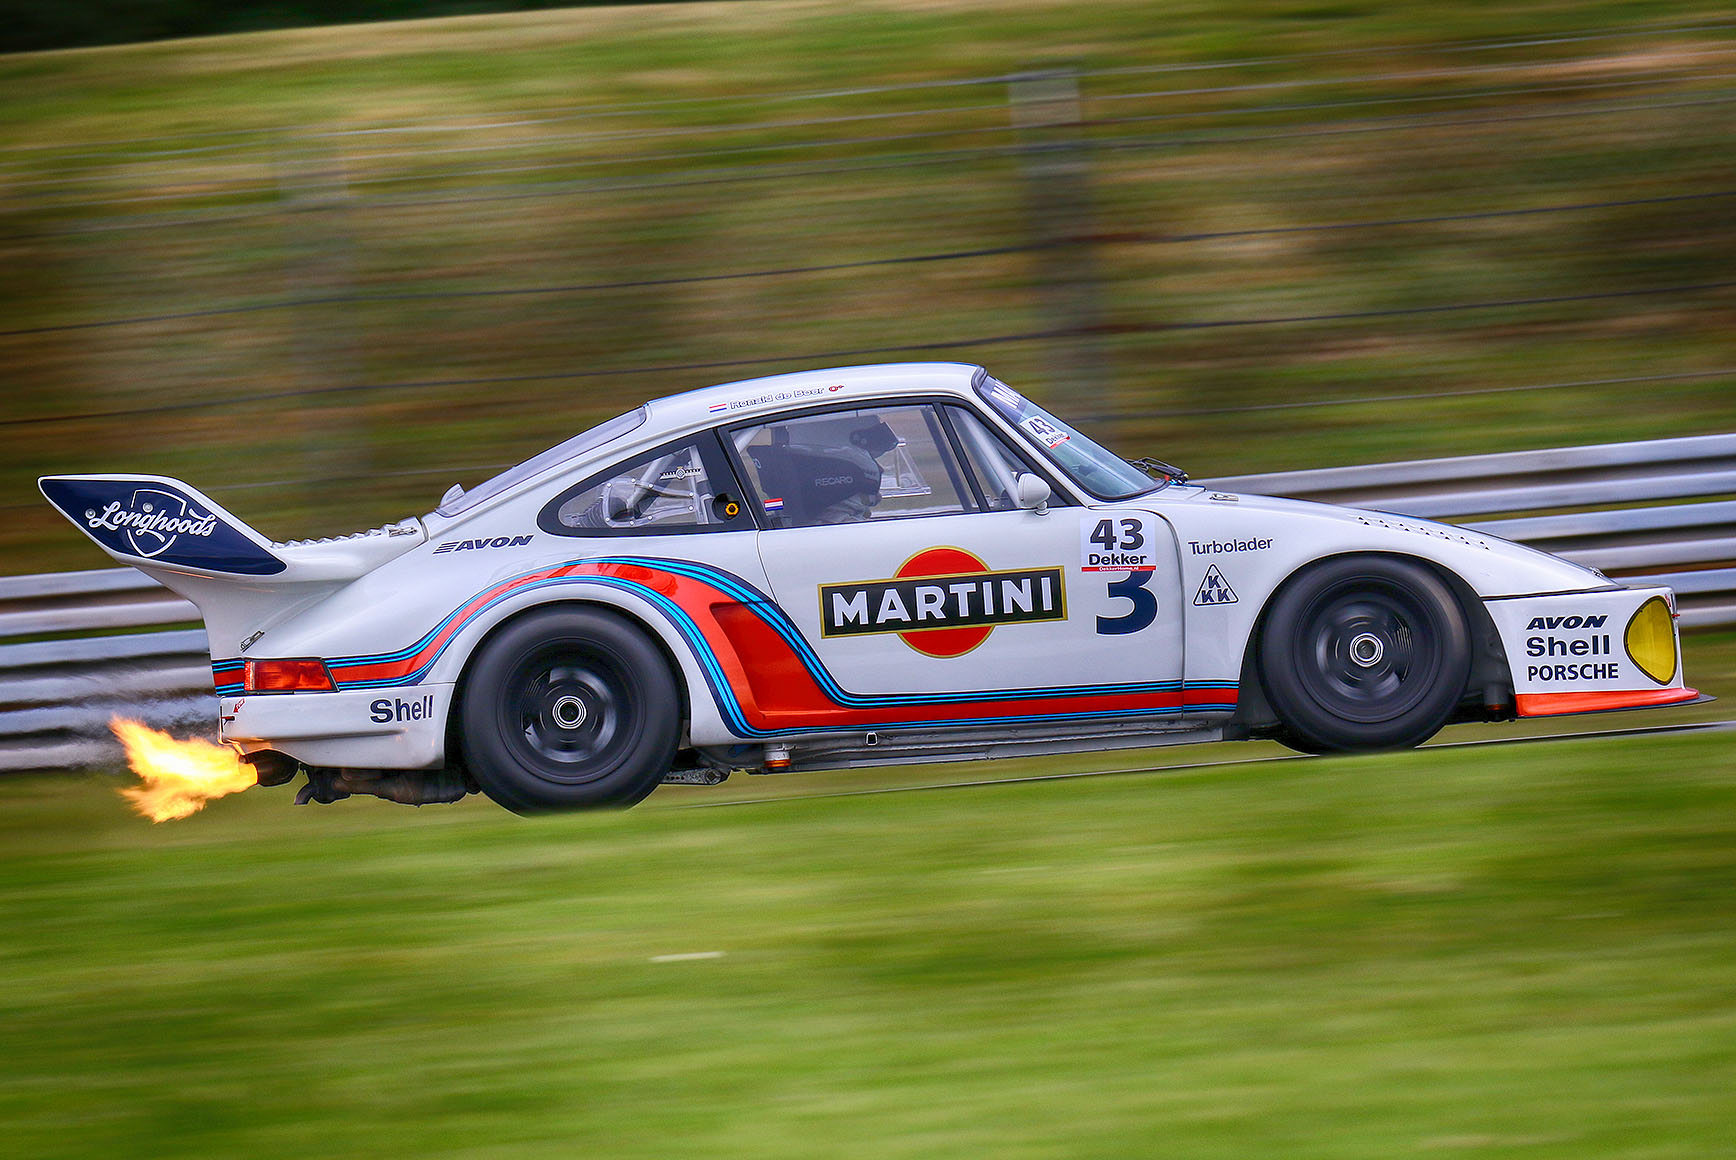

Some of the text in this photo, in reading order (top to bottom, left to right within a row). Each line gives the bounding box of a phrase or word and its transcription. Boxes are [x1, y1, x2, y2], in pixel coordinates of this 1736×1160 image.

[730, 395, 773, 410] Ronald
[1028, 418, 1055, 434] 43
[815, 476, 853, 487] RECARO
[89, 501, 218, 543] Longhoods
[1089, 518, 1144, 551] 43
[455, 535, 534, 552] AVON
[1188, 537, 1274, 555] Turbolader
[1088, 553, 1147, 566] Dekker
[1208, 575, 1220, 589] K
[831, 576, 1054, 627] MARTINI
[1201, 588, 1231, 604] K K
[1526, 615, 1608, 630] AVON
[1526, 635, 1610, 657] Shell
[1527, 663, 1619, 681] PORSCHE
[369, 695, 434, 725] Shell
